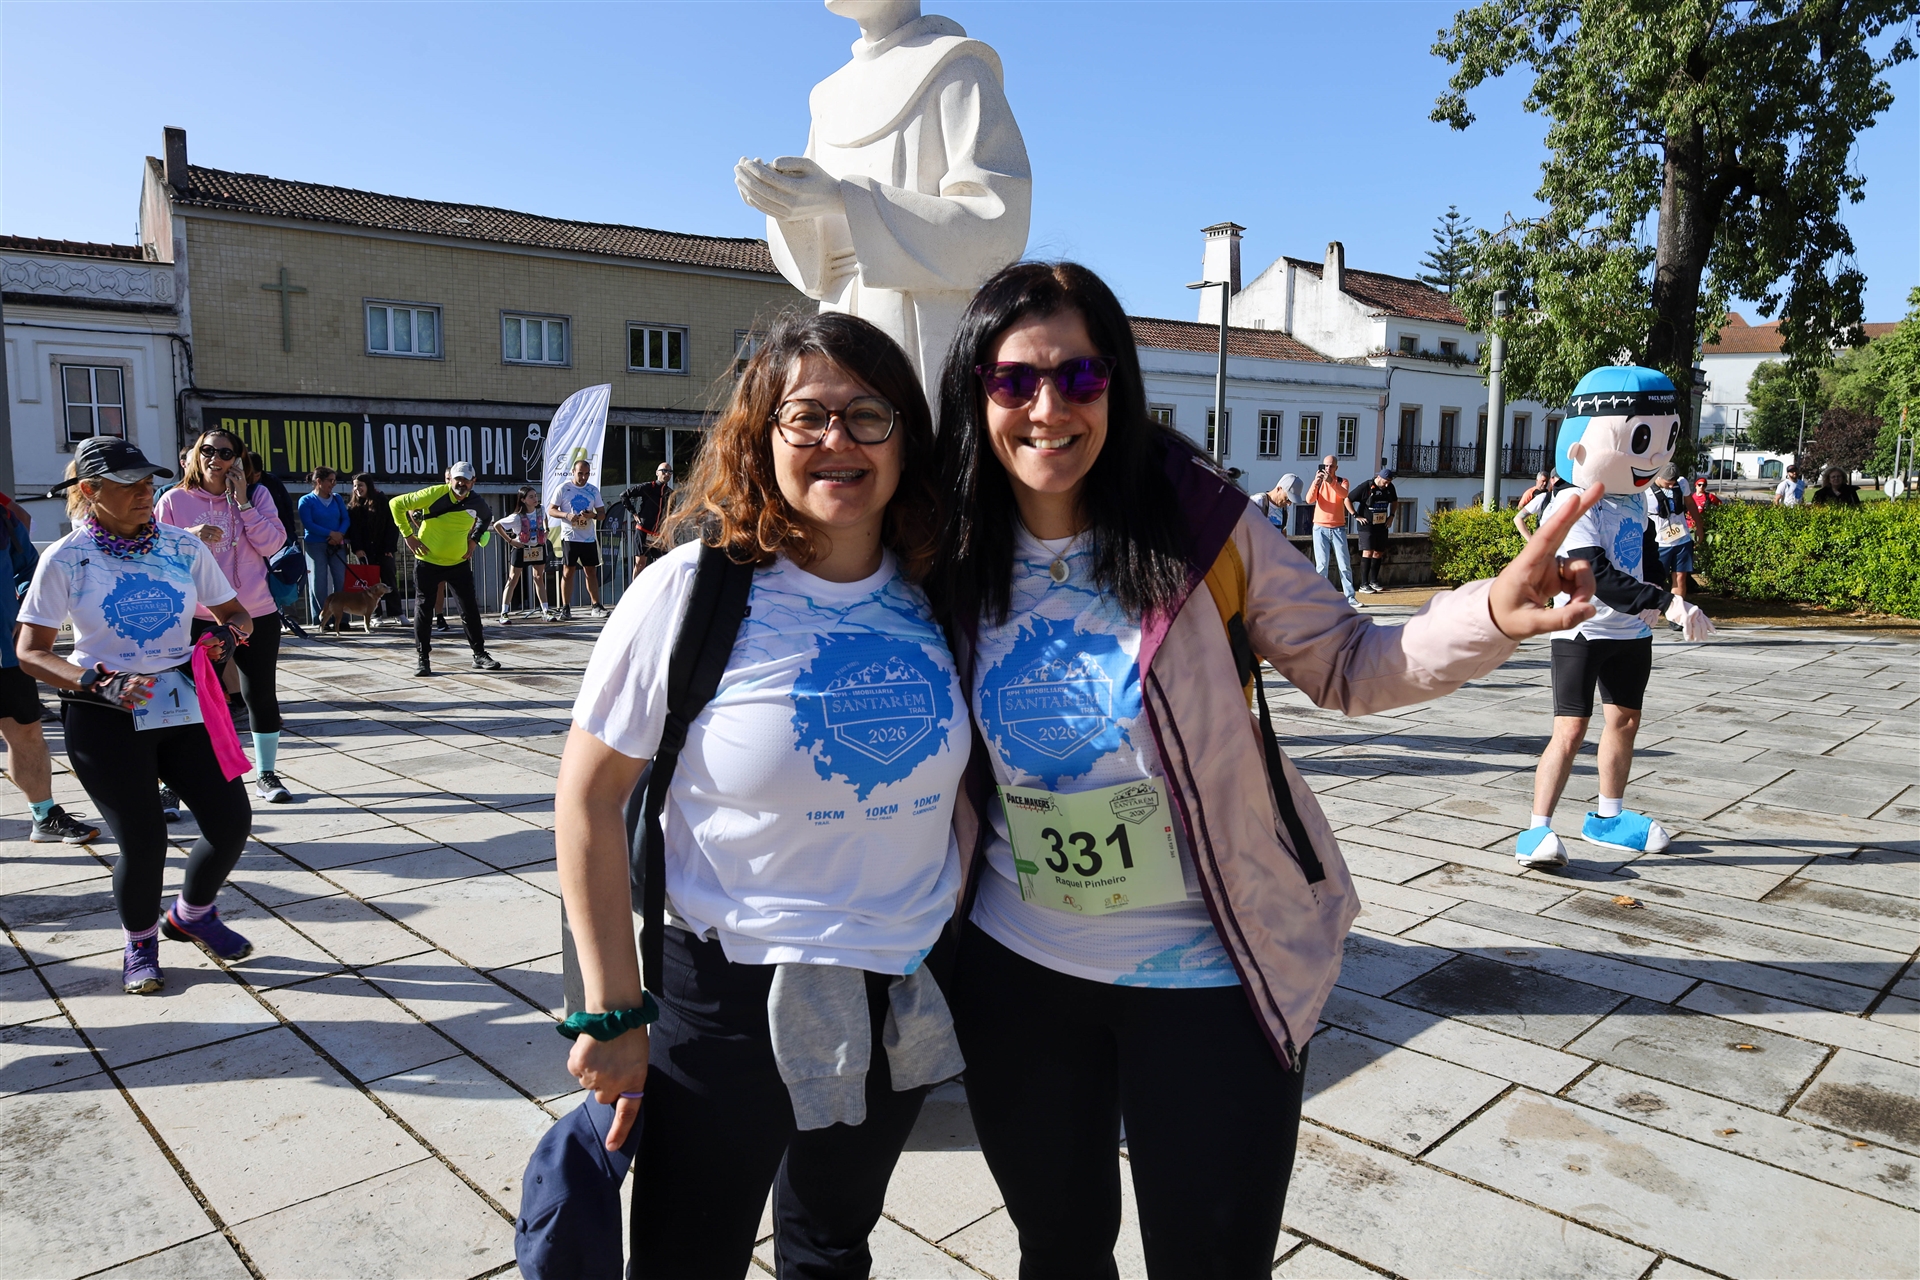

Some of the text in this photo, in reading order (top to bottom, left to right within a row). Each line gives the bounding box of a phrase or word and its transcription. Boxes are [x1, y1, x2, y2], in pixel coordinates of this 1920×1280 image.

[363, 414, 376, 474] À
[383, 423, 439, 475] CASA
[446, 425, 473, 468] DO
[481, 427, 512, 475] PAI
[1666, 527, 1681, 538] 200
[120, 602, 168, 612] SANTARÉM
[59, 622, 72, 632] ia
[139, 615, 159, 624] 2026
[168, 687, 180, 708] 1
[832, 691, 926, 713] SANTARÉM
[1005, 690, 1100, 711] SANTARÉM
[868, 726, 907, 744] 2026
[1038, 725, 1077, 741] 2026
[806, 793, 941, 821] 18KM 10KM 10KM
[1041, 823, 1134, 877] 331
[1055, 875, 1127, 888] Raquel Pinheiro
